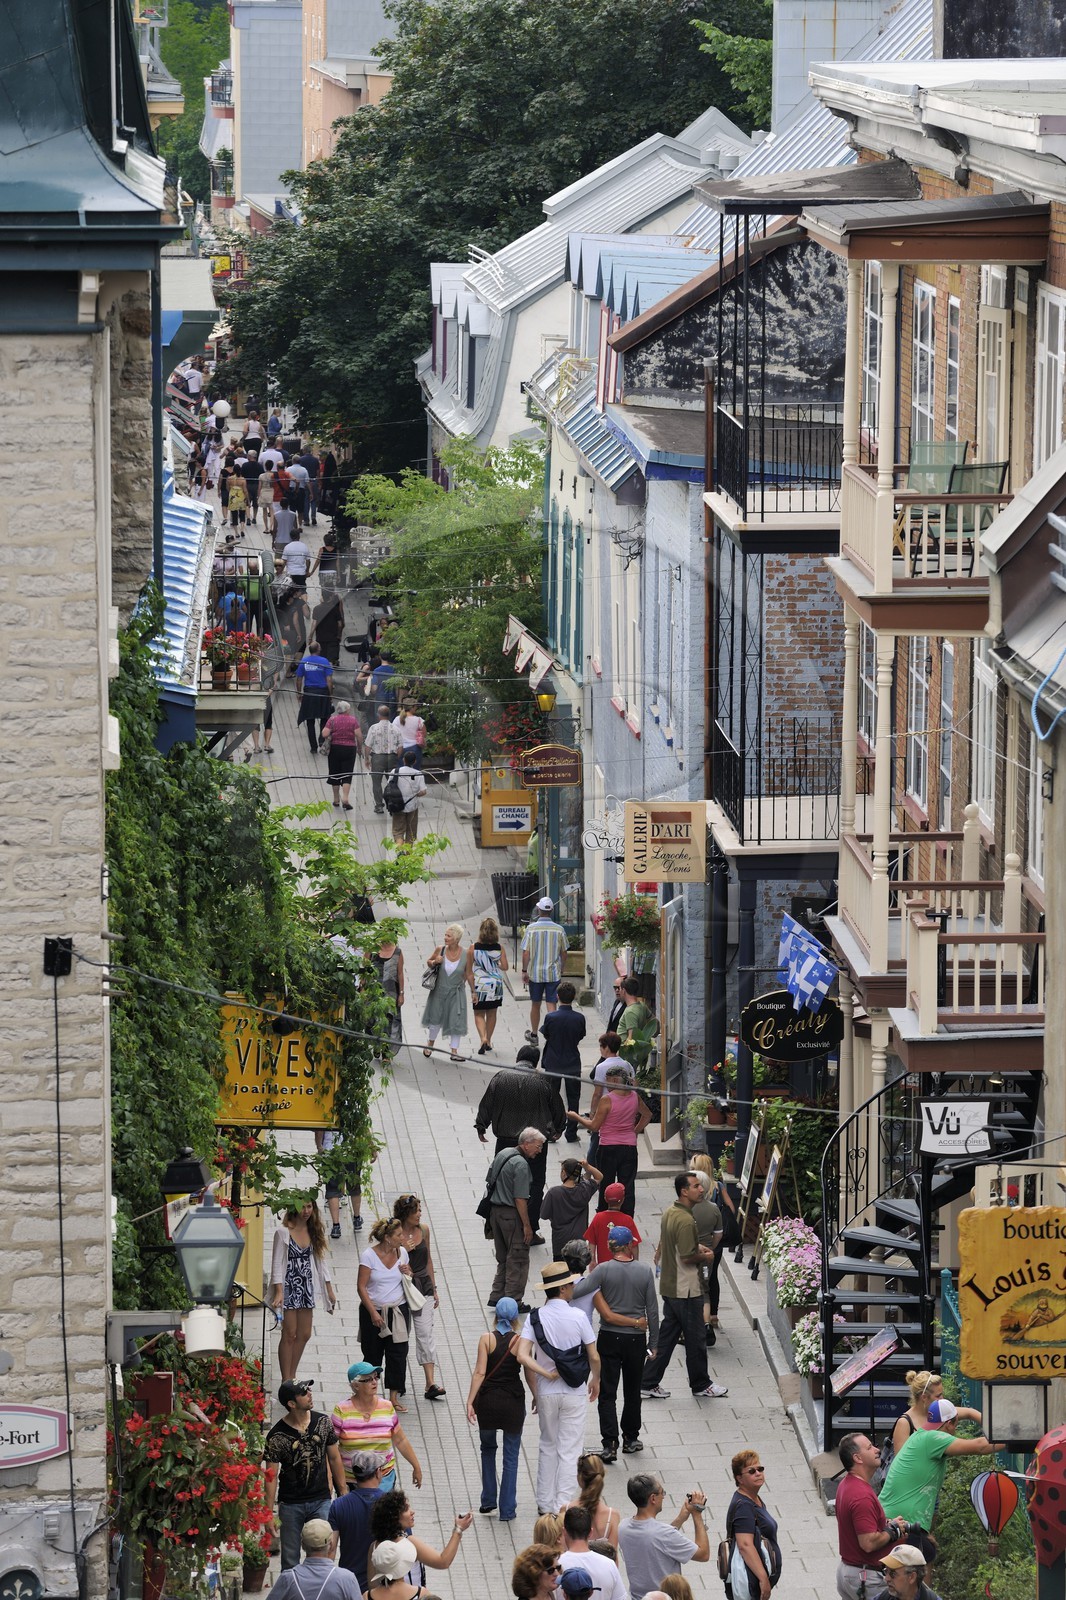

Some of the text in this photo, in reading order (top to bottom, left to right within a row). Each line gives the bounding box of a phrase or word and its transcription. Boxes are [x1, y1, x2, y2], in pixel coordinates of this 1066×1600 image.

[651, 824, 692, 838] D'ART
[633, 811, 648, 874] GALERIE
[661, 860, 691, 873] Denis
[756, 1002, 786, 1010] Boutique
[796, 1041, 831, 1049] Exclusivité
[235, 1038, 316, 1077] VIVES
[233, 1082, 315, 1096] joaillerie
[962, 1258, 1051, 1312] Louis
